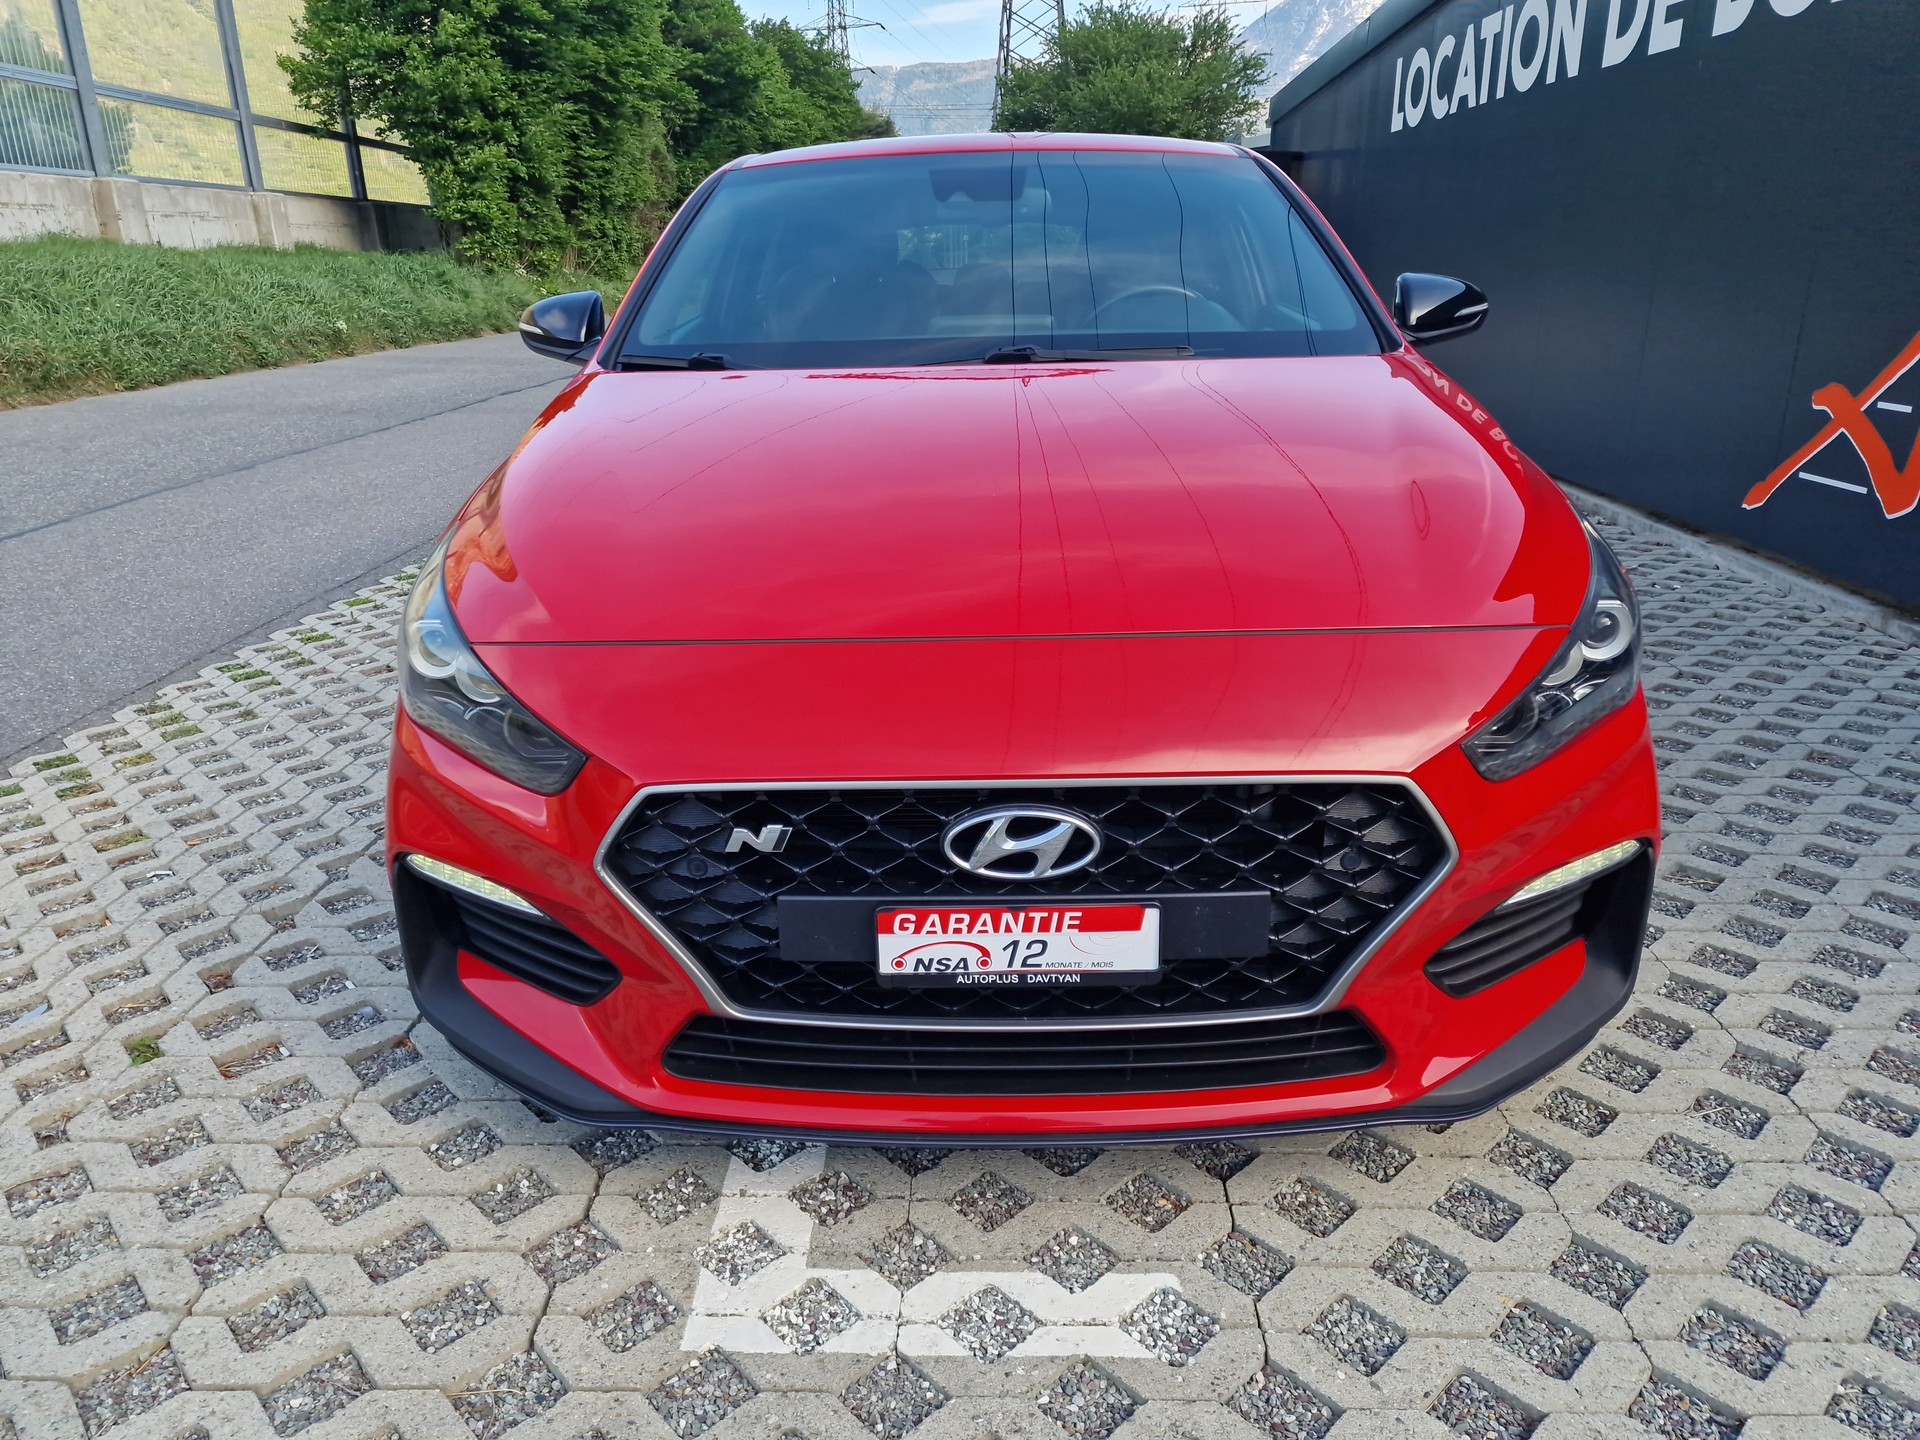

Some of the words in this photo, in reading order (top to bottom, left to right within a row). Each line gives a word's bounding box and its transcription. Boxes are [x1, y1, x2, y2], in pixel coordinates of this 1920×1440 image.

[1391, 0, 1588, 132] LOCATION
[1602, 0, 1684, 68] DE
[892, 912, 1083, 936] GARANTIE
[913, 957, 970, 972] NSA
[1001, 939, 1049, 969] 12
[956, 974, 1019, 984] AUTOPLUS
[1027, 973, 1081, 984] DAVTYAN
